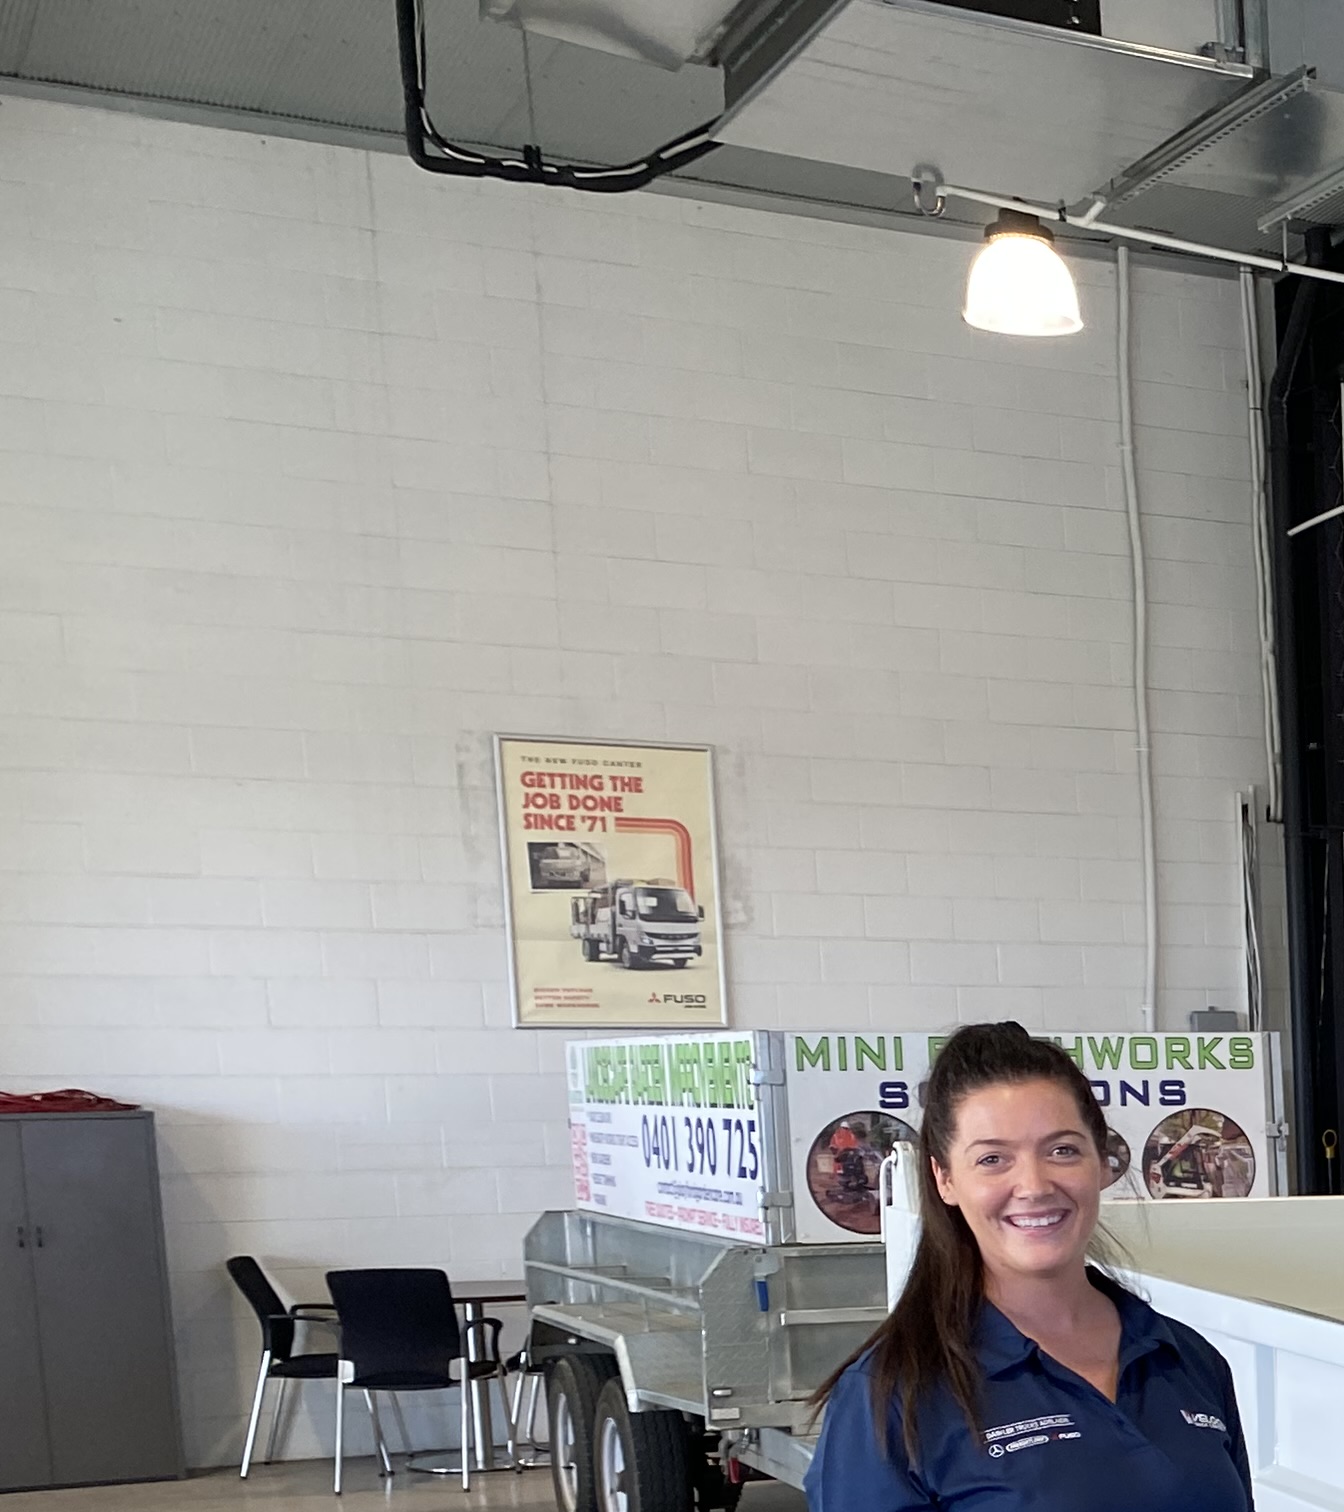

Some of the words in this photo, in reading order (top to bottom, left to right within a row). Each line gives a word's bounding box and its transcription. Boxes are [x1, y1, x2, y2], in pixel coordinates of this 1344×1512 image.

[603, 760, 642, 768] CANTER
[520, 771, 604, 791] GETTING
[608, 775, 643, 793] THE
[522, 792, 561, 810] JOB
[568, 794, 623, 812] DONE
[523, 813, 576, 831] SINCE
[581, 815, 607, 833] '71
[663, 994, 706, 1004] FUSO
[795, 1036, 904, 1071] MINI
[927, 1035, 1254, 1070] HWORKS
[641, 1114, 679, 1171] 0401
[684, 1116, 717, 1176] 390
[722, 1118, 759, 1180] 725
